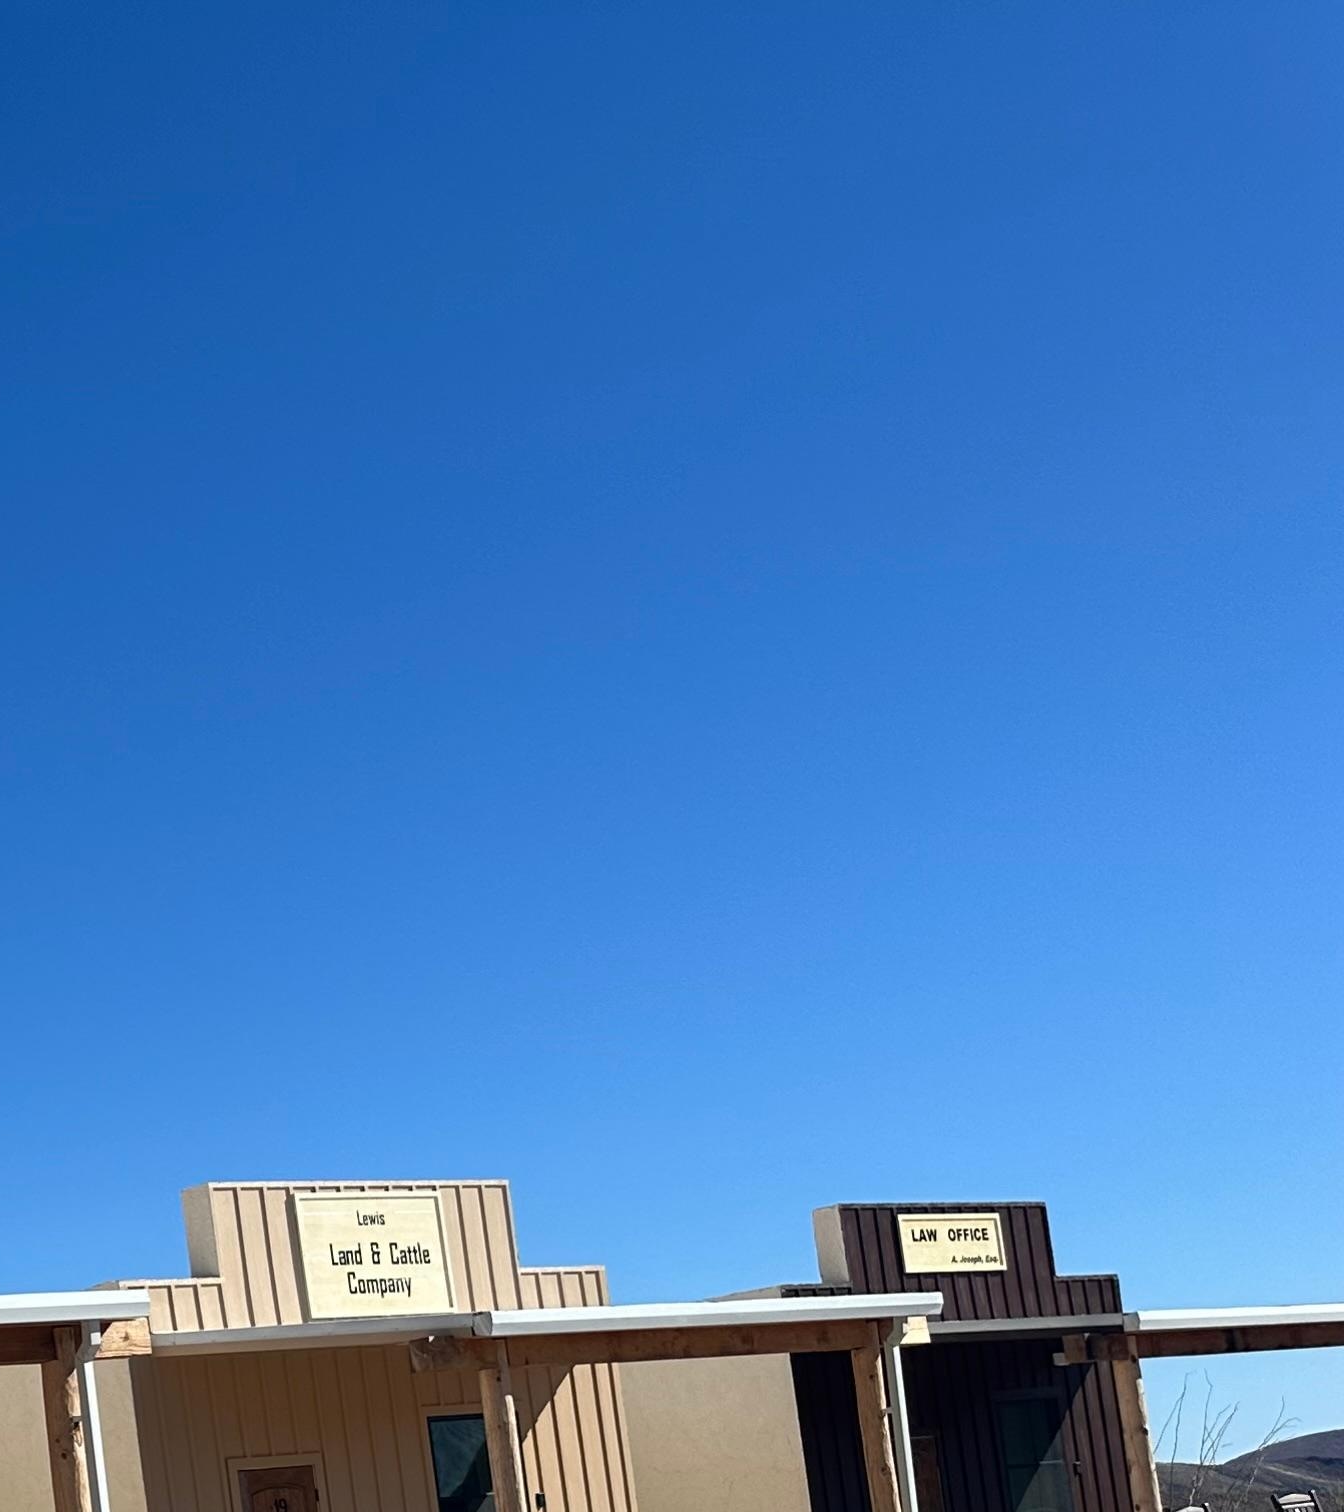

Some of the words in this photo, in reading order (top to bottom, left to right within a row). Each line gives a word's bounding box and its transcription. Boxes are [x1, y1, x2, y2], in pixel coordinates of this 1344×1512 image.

[356, 1210, 386, 1226] Lewis
[911, 1228, 937, 1242] LAW
[947, 1227, 990, 1242] OFFICE
[329, 1242, 363, 1266] Land
[370, 1241, 381, 1265] &
[389, 1241, 431, 1265] Cattle
[347, 1271, 412, 1298] Company
